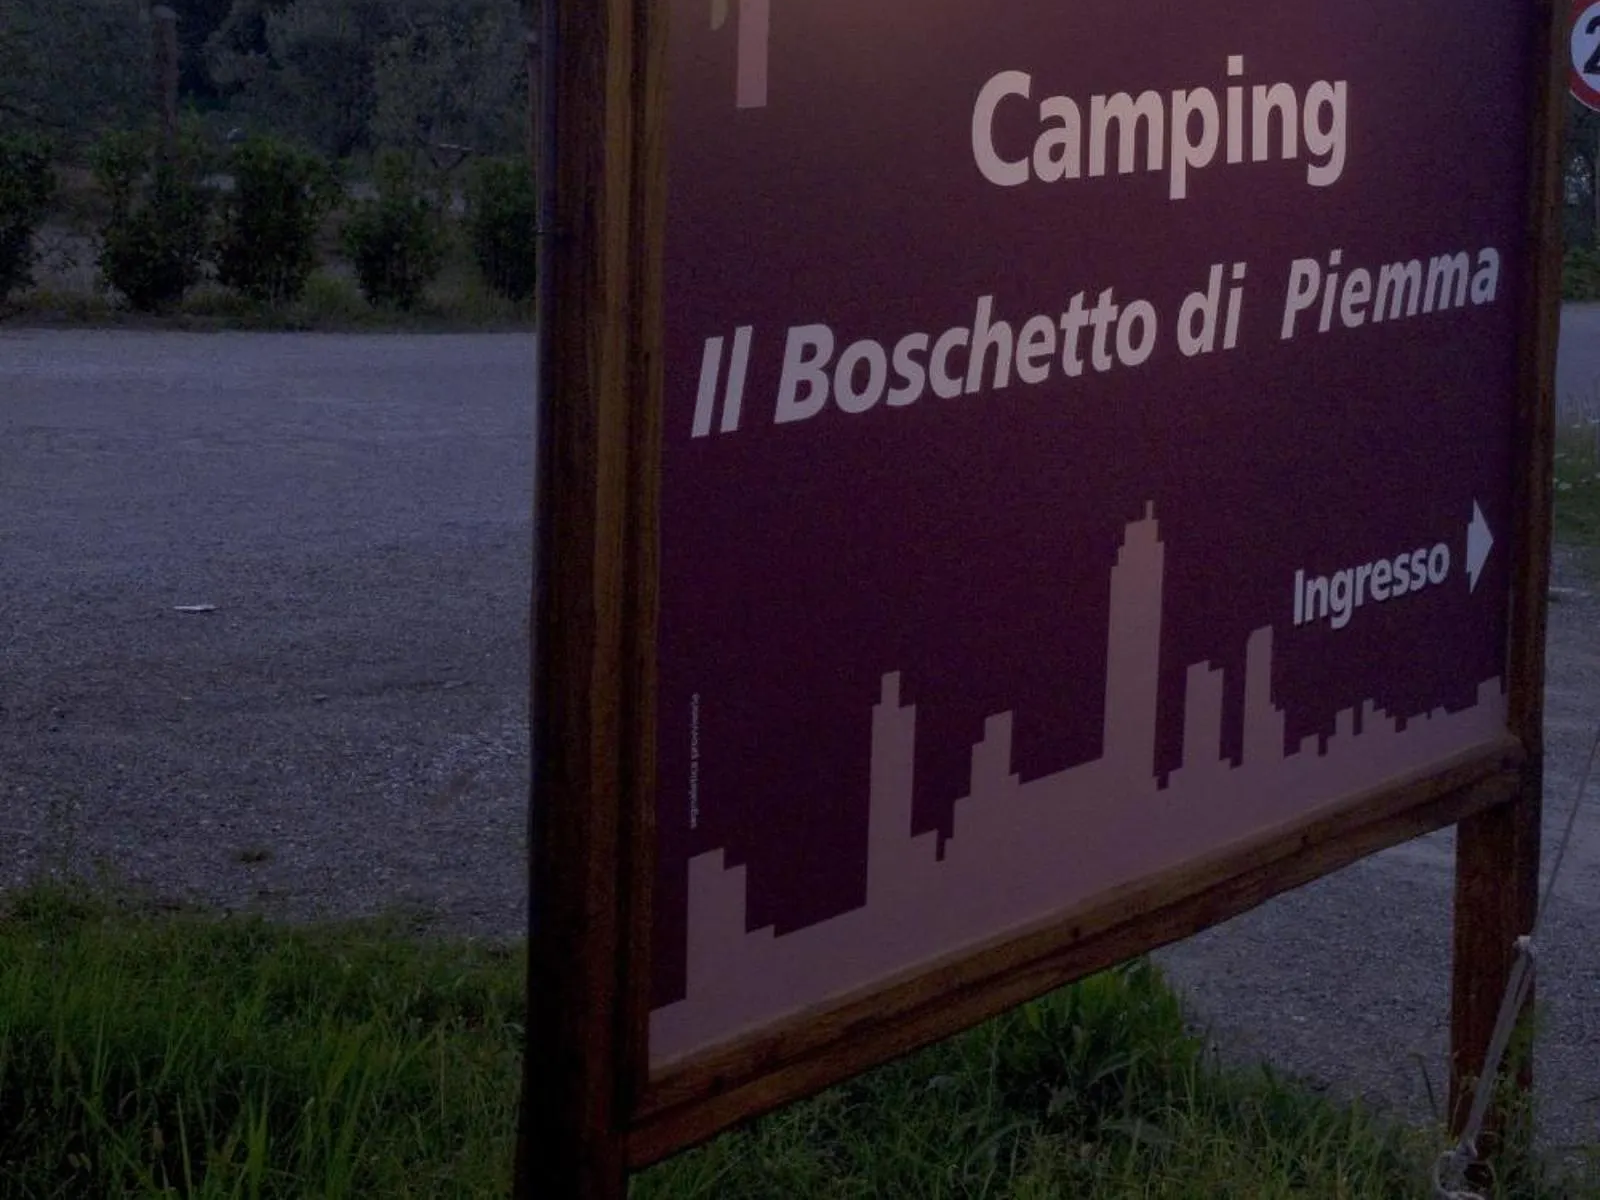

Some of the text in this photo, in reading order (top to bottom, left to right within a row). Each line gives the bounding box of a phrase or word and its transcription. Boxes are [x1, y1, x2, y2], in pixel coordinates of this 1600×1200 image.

[971, 54, 1347, 200] Camping
[690, 247, 1500, 438] Il Boschetto di Piemma
[1293, 542, 1451, 629] Ingresso
